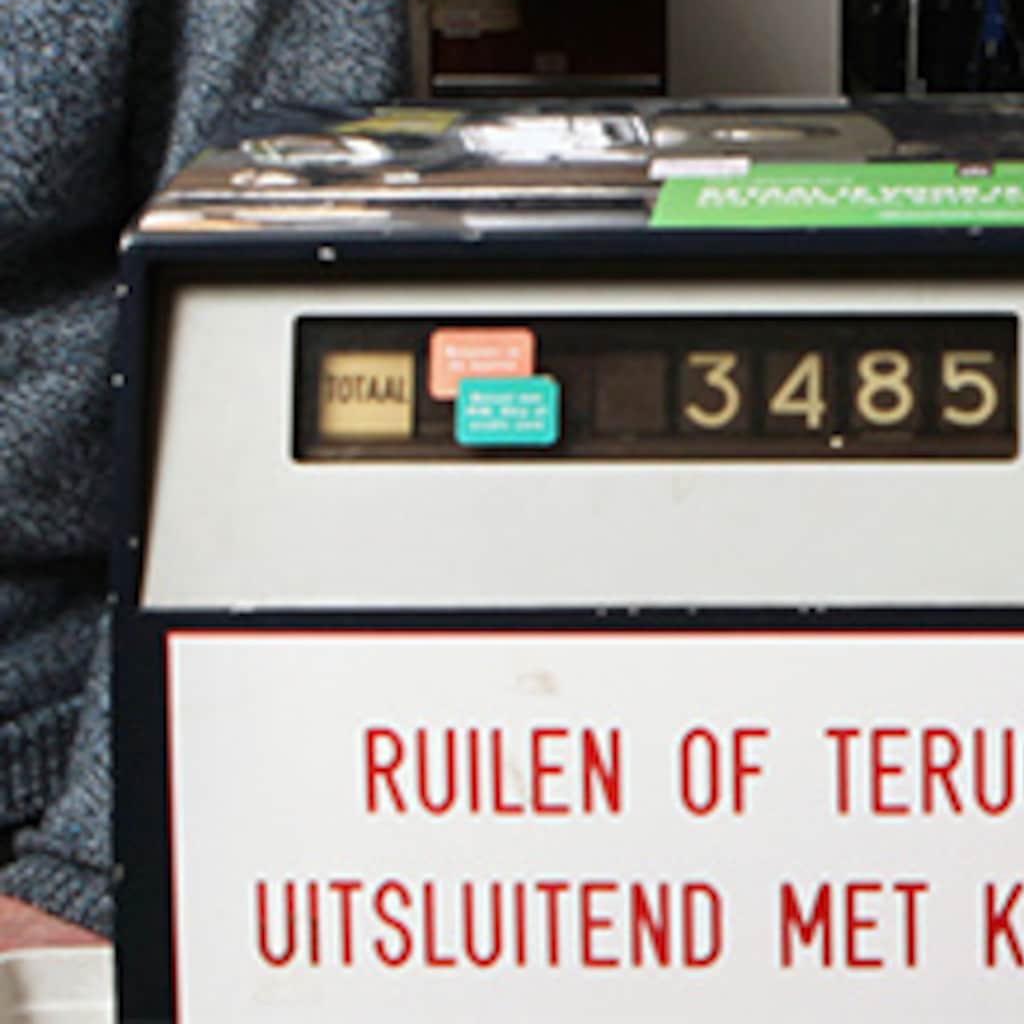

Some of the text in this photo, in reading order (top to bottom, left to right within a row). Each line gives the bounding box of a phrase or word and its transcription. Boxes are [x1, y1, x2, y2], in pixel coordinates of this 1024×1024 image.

[324, 375, 409, 404] TOTAAL
[366, 728, 622, 816] RUILEN
[681, 728, 770, 817] OF
[257, 881, 723, 969] UITSLUITEND
[781, 881, 929, 969] MET
